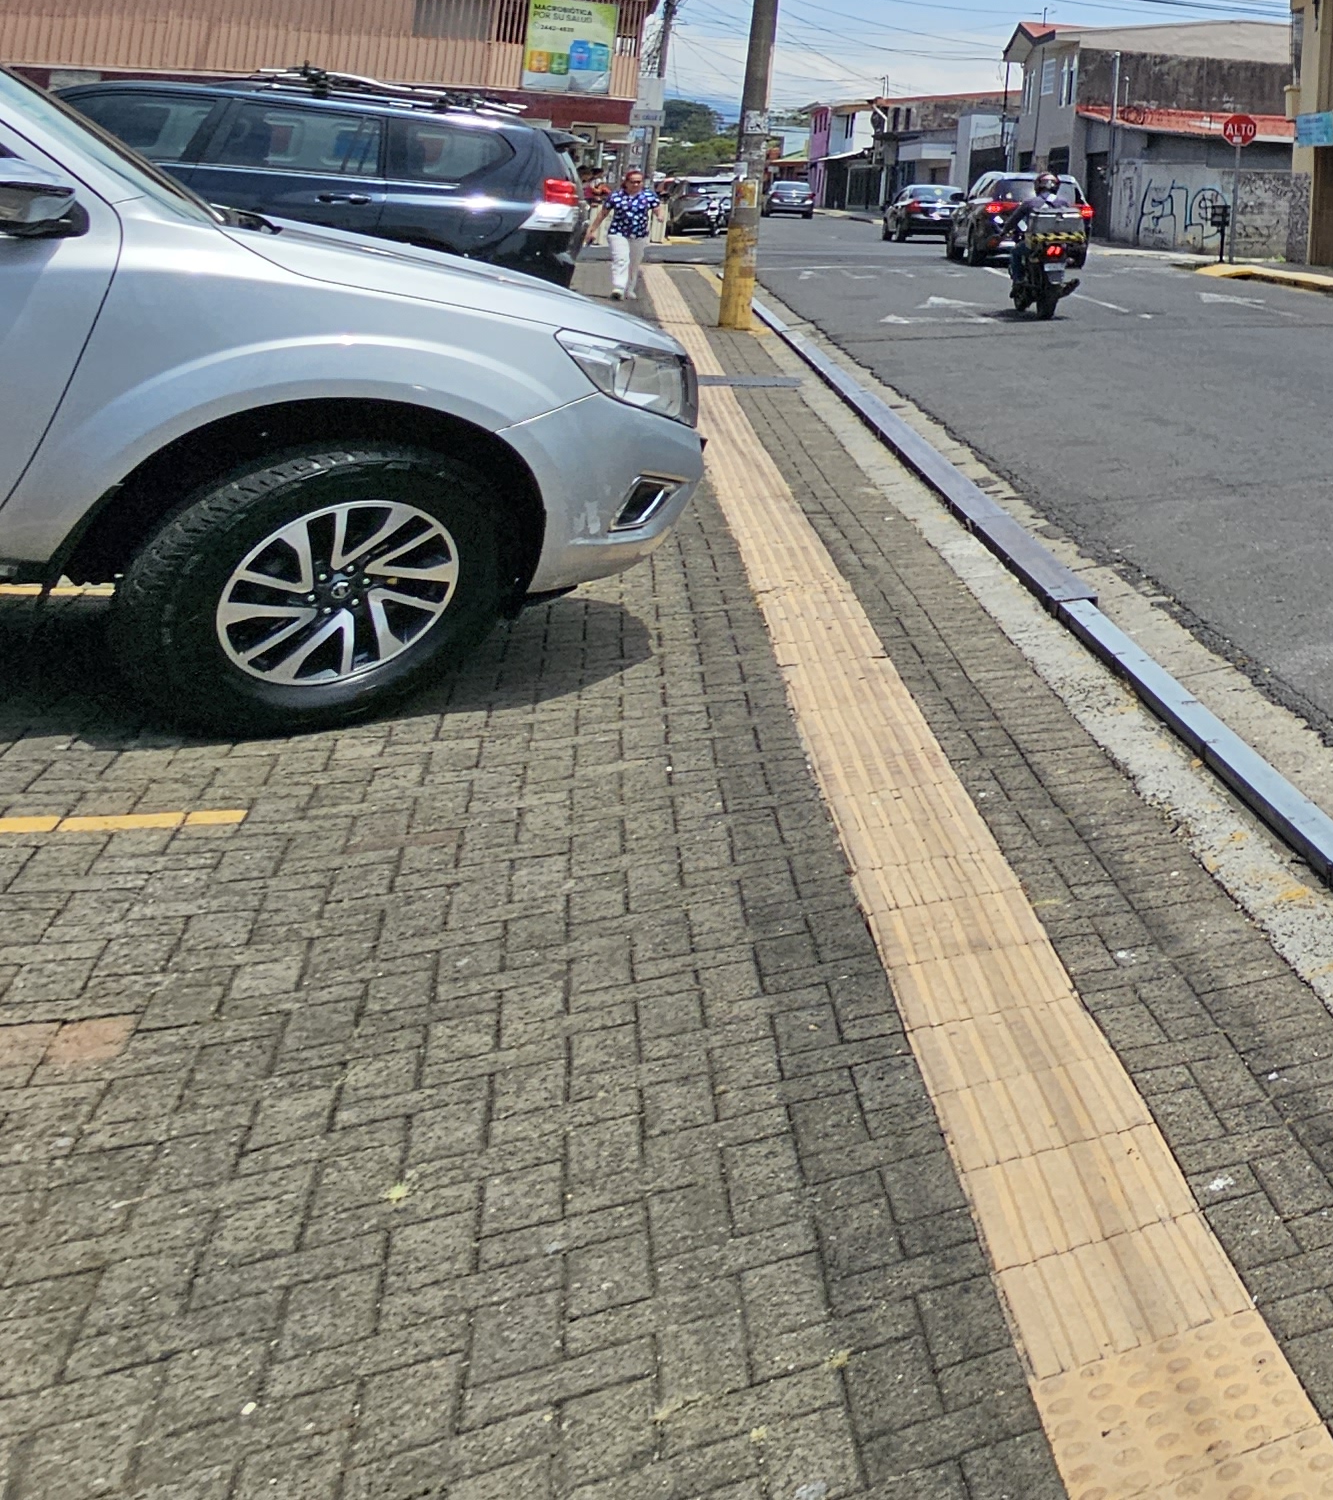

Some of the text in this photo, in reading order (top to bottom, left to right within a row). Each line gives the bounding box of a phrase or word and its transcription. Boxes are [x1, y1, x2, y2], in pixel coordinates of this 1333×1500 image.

[533, 3, 592, 16] MACROBIÓTICA
[533, 11, 592, 23] POR SU SALUD
[1226, 123, 1255, 136] ALTO
